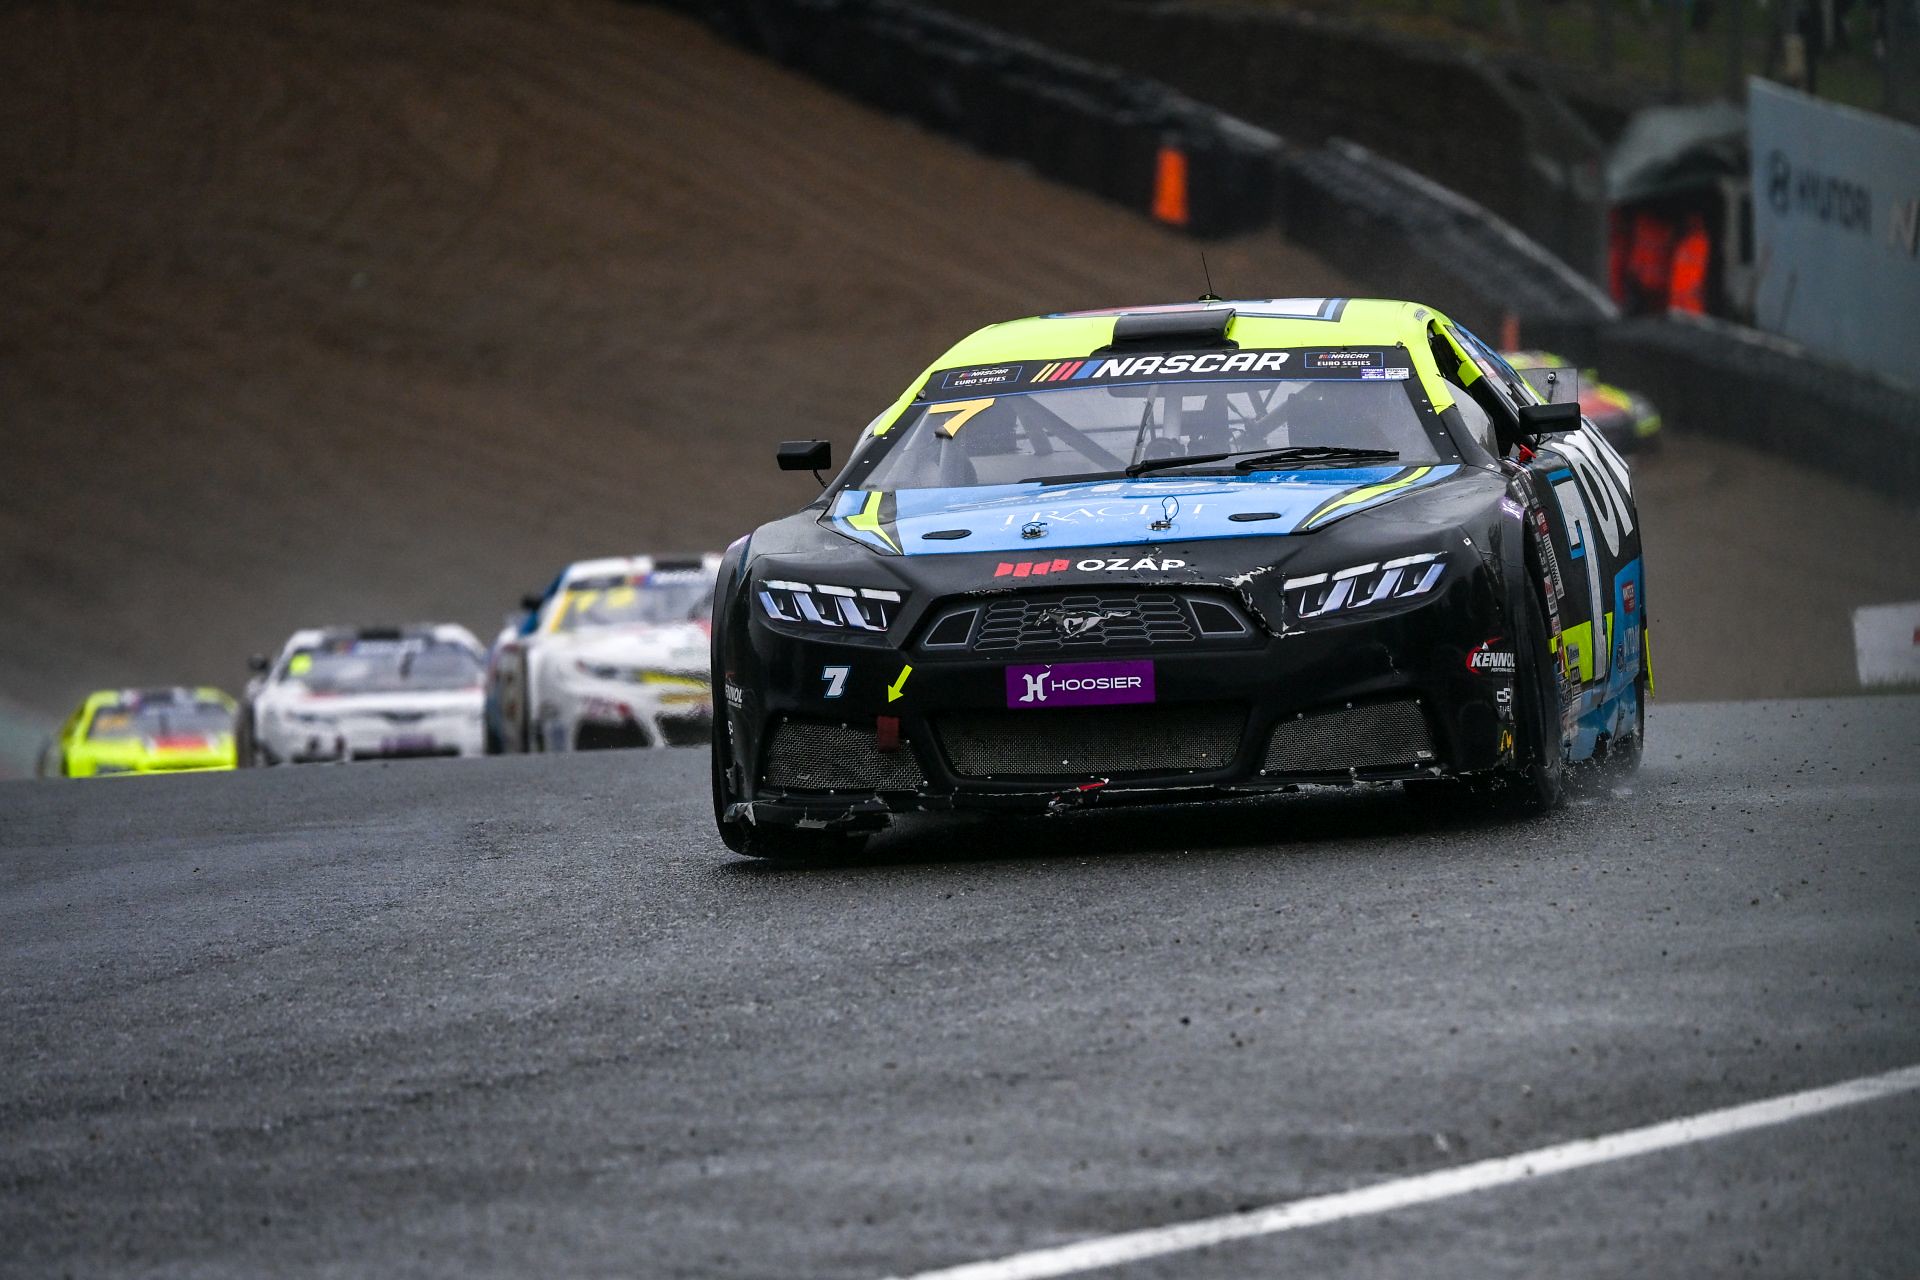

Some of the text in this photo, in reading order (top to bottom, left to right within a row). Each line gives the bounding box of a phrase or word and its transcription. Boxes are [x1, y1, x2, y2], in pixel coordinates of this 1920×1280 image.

[971, 368, 1009, 377] NASCAR
[1092, 352, 1290, 379] NASCAR
[979, 376, 1007, 384] SERIES
[928, 397, 996, 438] 7
[1076, 558, 1186, 572] OZAP
[1471, 652, 1516, 668] KENNOL
[822, 666, 850, 698] 7
[1052, 676, 1142, 692] HOOSIER
